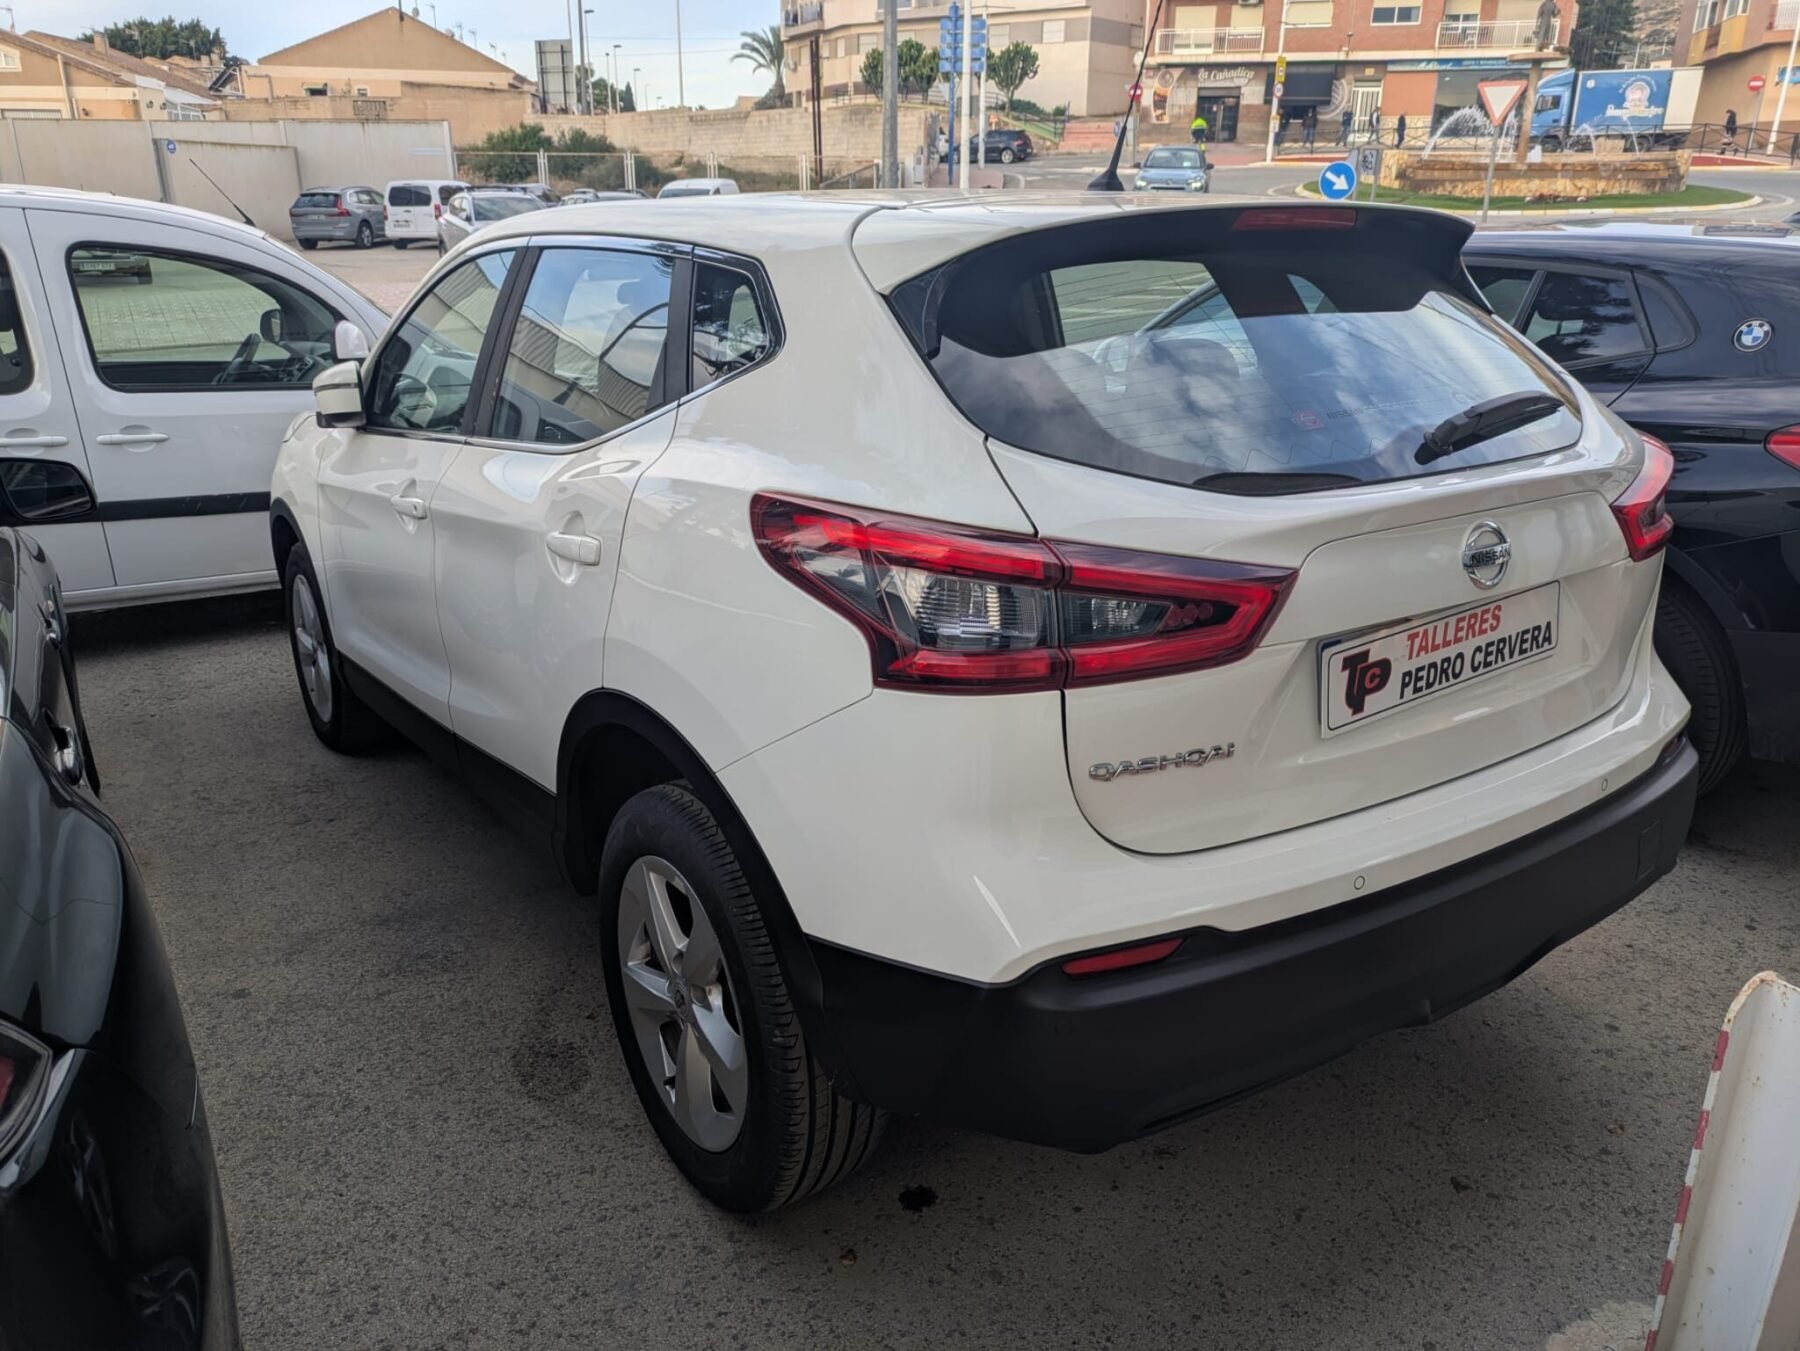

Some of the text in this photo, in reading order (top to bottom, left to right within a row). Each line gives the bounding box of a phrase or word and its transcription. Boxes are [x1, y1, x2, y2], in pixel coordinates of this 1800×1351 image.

[1471, 544, 1511, 567] NISSAN
[1406, 604, 1502, 661] TALLERES
[1400, 621, 1552, 701] PEDRO CERVERA
[1088, 742, 1235, 782] QASHQAI
